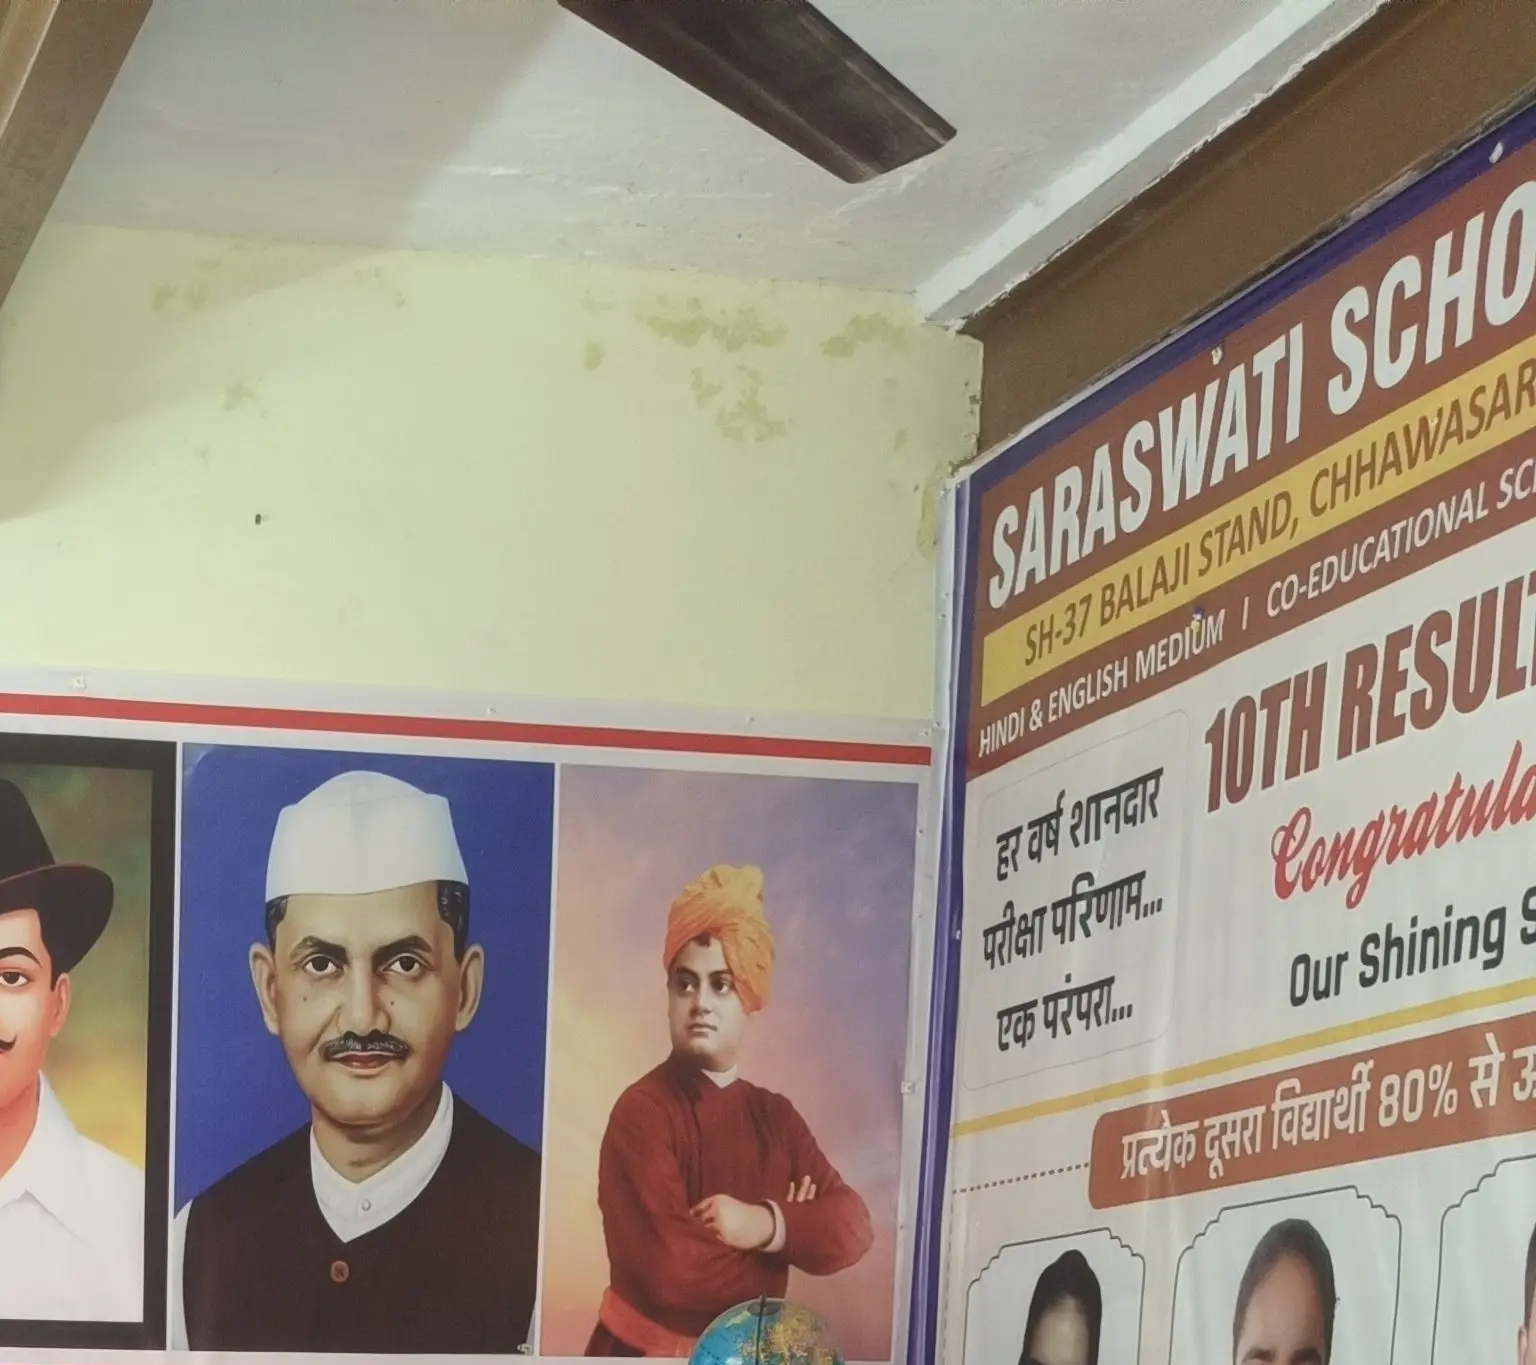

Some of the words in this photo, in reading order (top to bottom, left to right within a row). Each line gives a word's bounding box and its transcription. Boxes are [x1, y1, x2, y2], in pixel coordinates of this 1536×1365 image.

[988, 323, 1303, 608] SARASWATI
[1328, 181, 1536, 416] SCHO
[1025, 593, 1092, 667] SH-37
[1101, 544, 1189, 627] BALAJI
[1198, 487, 1299, 577] STAND,
[1309, 358, 1536, 517] CHHAWASAR
[978, 704, 1024, 759] HINDI
[1028, 695, 1044, 732] &
[1047, 664, 1127, 725] ENGLISH
[1134, 607, 1224, 683] MEDIUM
[1265, 488, 1489, 617] CO-EDUCATIONAL
[1498, 452, 1536, 511] SC
[1205, 662, 1328, 813] 10TH
[996, 824, 1024, 882] हर
[1027, 788, 1066, 863] वर्ष
[1069, 766, 1164, 848] शानदार
[983, 900, 1047, 970] परीक्षा
[1051, 870, 1163, 945] परिणाम...
[1290, 945, 1349, 1008] Our
[1359, 900, 1507, 989] Shining
[997, 999, 1038, 1051] एक
[1042, 972, 1133, 1038] परंपरा...
[1120, 1108, 1200, 1180] प्रत्येक
[1204, 1105, 1266, 1180] दूसरा
[1271, 1058, 1374, 1150] विद्यार्थी
[1378, 1060, 1458, 1129] 80%
[1468, 1032, 1506, 1109] से
